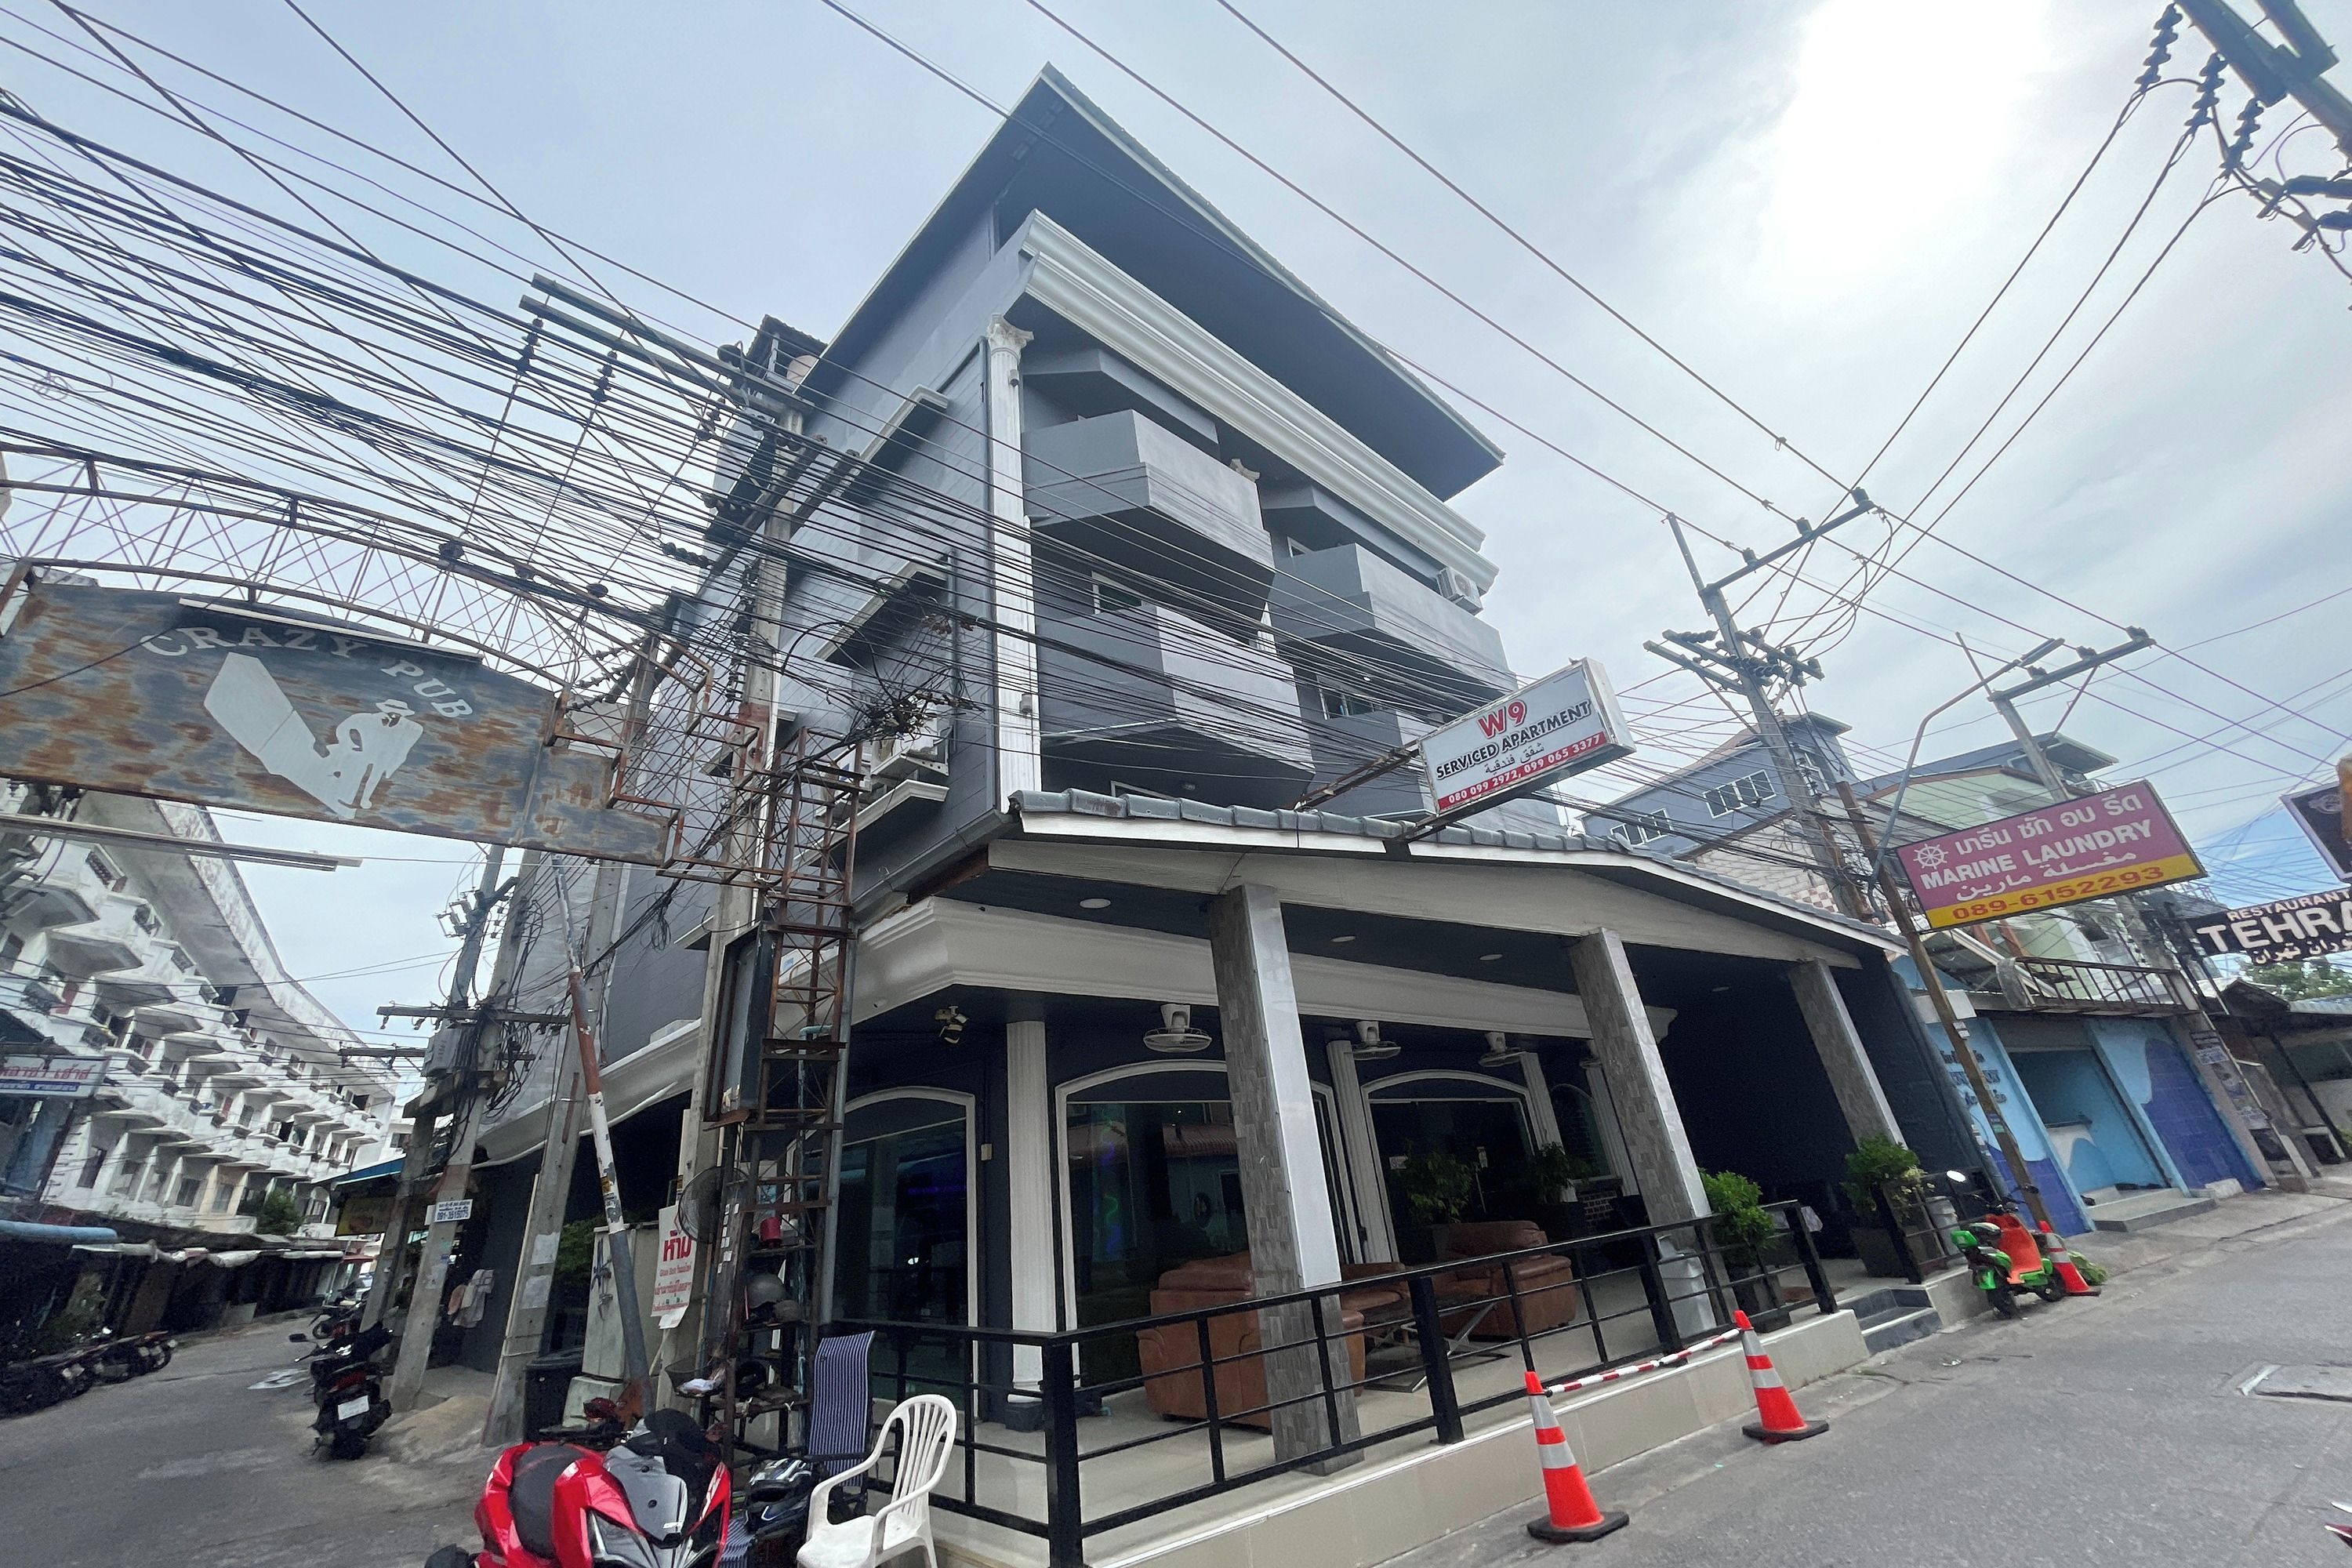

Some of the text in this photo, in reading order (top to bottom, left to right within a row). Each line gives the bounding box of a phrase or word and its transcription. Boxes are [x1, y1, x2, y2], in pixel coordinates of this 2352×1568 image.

[139, 625, 475, 720] CRAZY PUB
[1436, 699, 1591, 779] SERVICED APARTMENT
[1477, 699, 1527, 739] W9
[1449, 735, 1601, 804] 080 099 2972, 099 065 3377
[1484, 742, 1544, 775] شقق فندقية
[1955, 792, 2143, 855] มารีน ซัก อบ รีด
[1920, 818, 2152, 890] MARINE LAUNDRY
[1956, 851, 2136, 902] مغسلة مارين
[1952, 866, 2165, 920] 089-6152293
[2227, 888, 2350, 921] RESTAURANT
[2252, 942, 2302, 964] تهران
[662, 1229, 693, 1261] ห้าม
